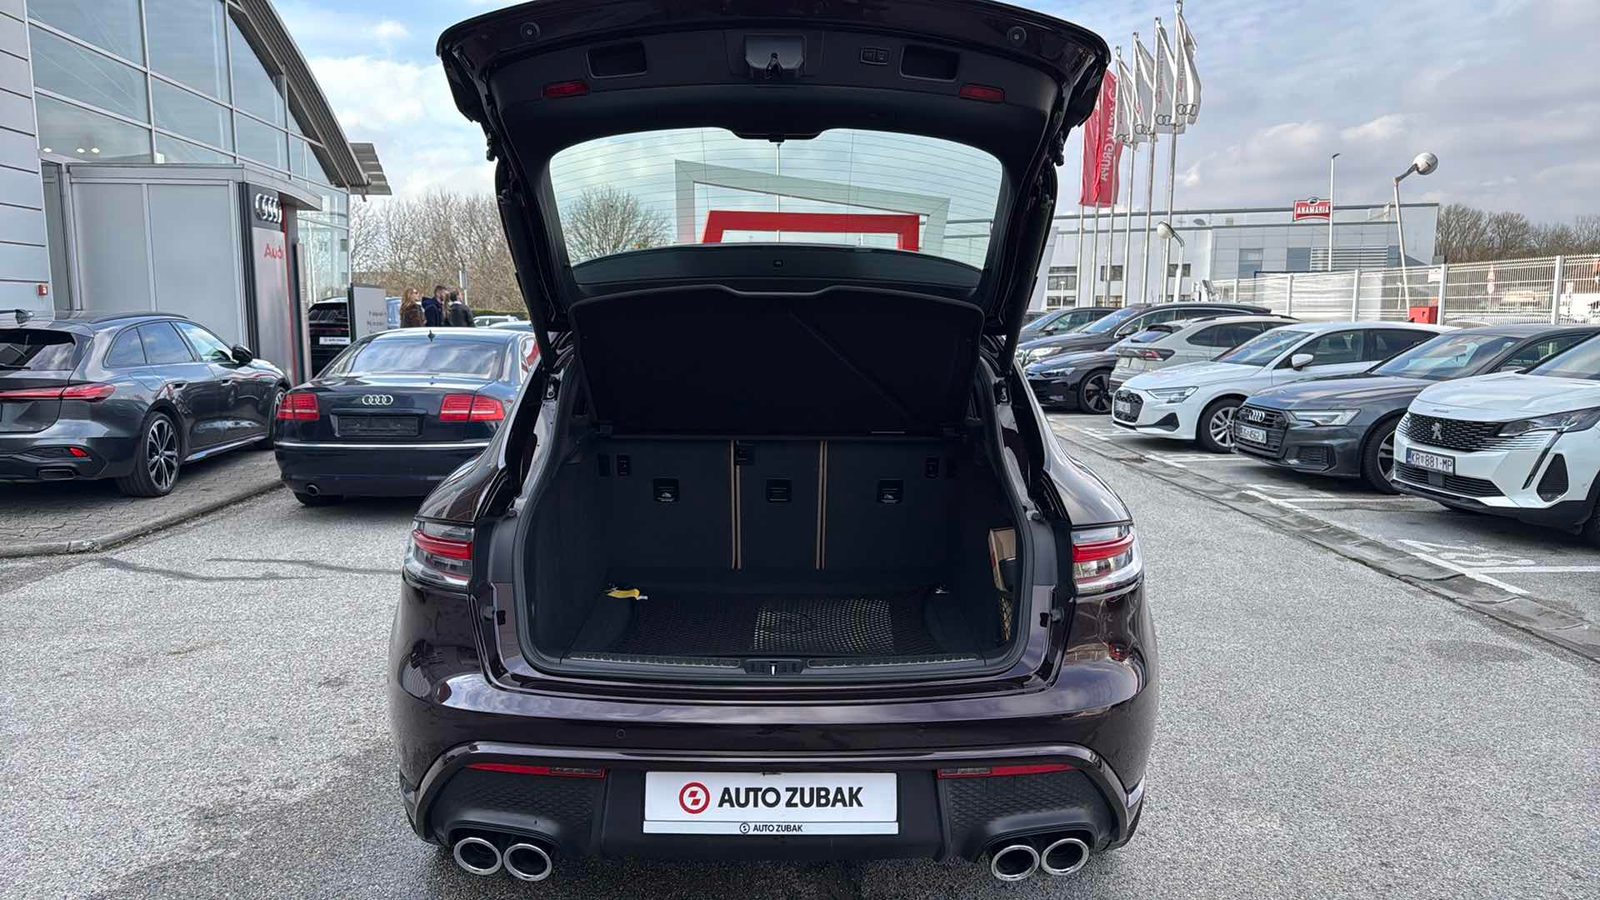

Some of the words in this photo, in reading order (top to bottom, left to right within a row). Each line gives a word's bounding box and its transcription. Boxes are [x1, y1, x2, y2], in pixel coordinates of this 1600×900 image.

[1296, 205, 1330, 214] ANAMARIA
[718, 787, 781, 808] AUTO
[785, 787, 863, 808] ZUBAK
[753, 824, 775, 832] AUTO
[775, 824, 803, 832] ZUBAK
